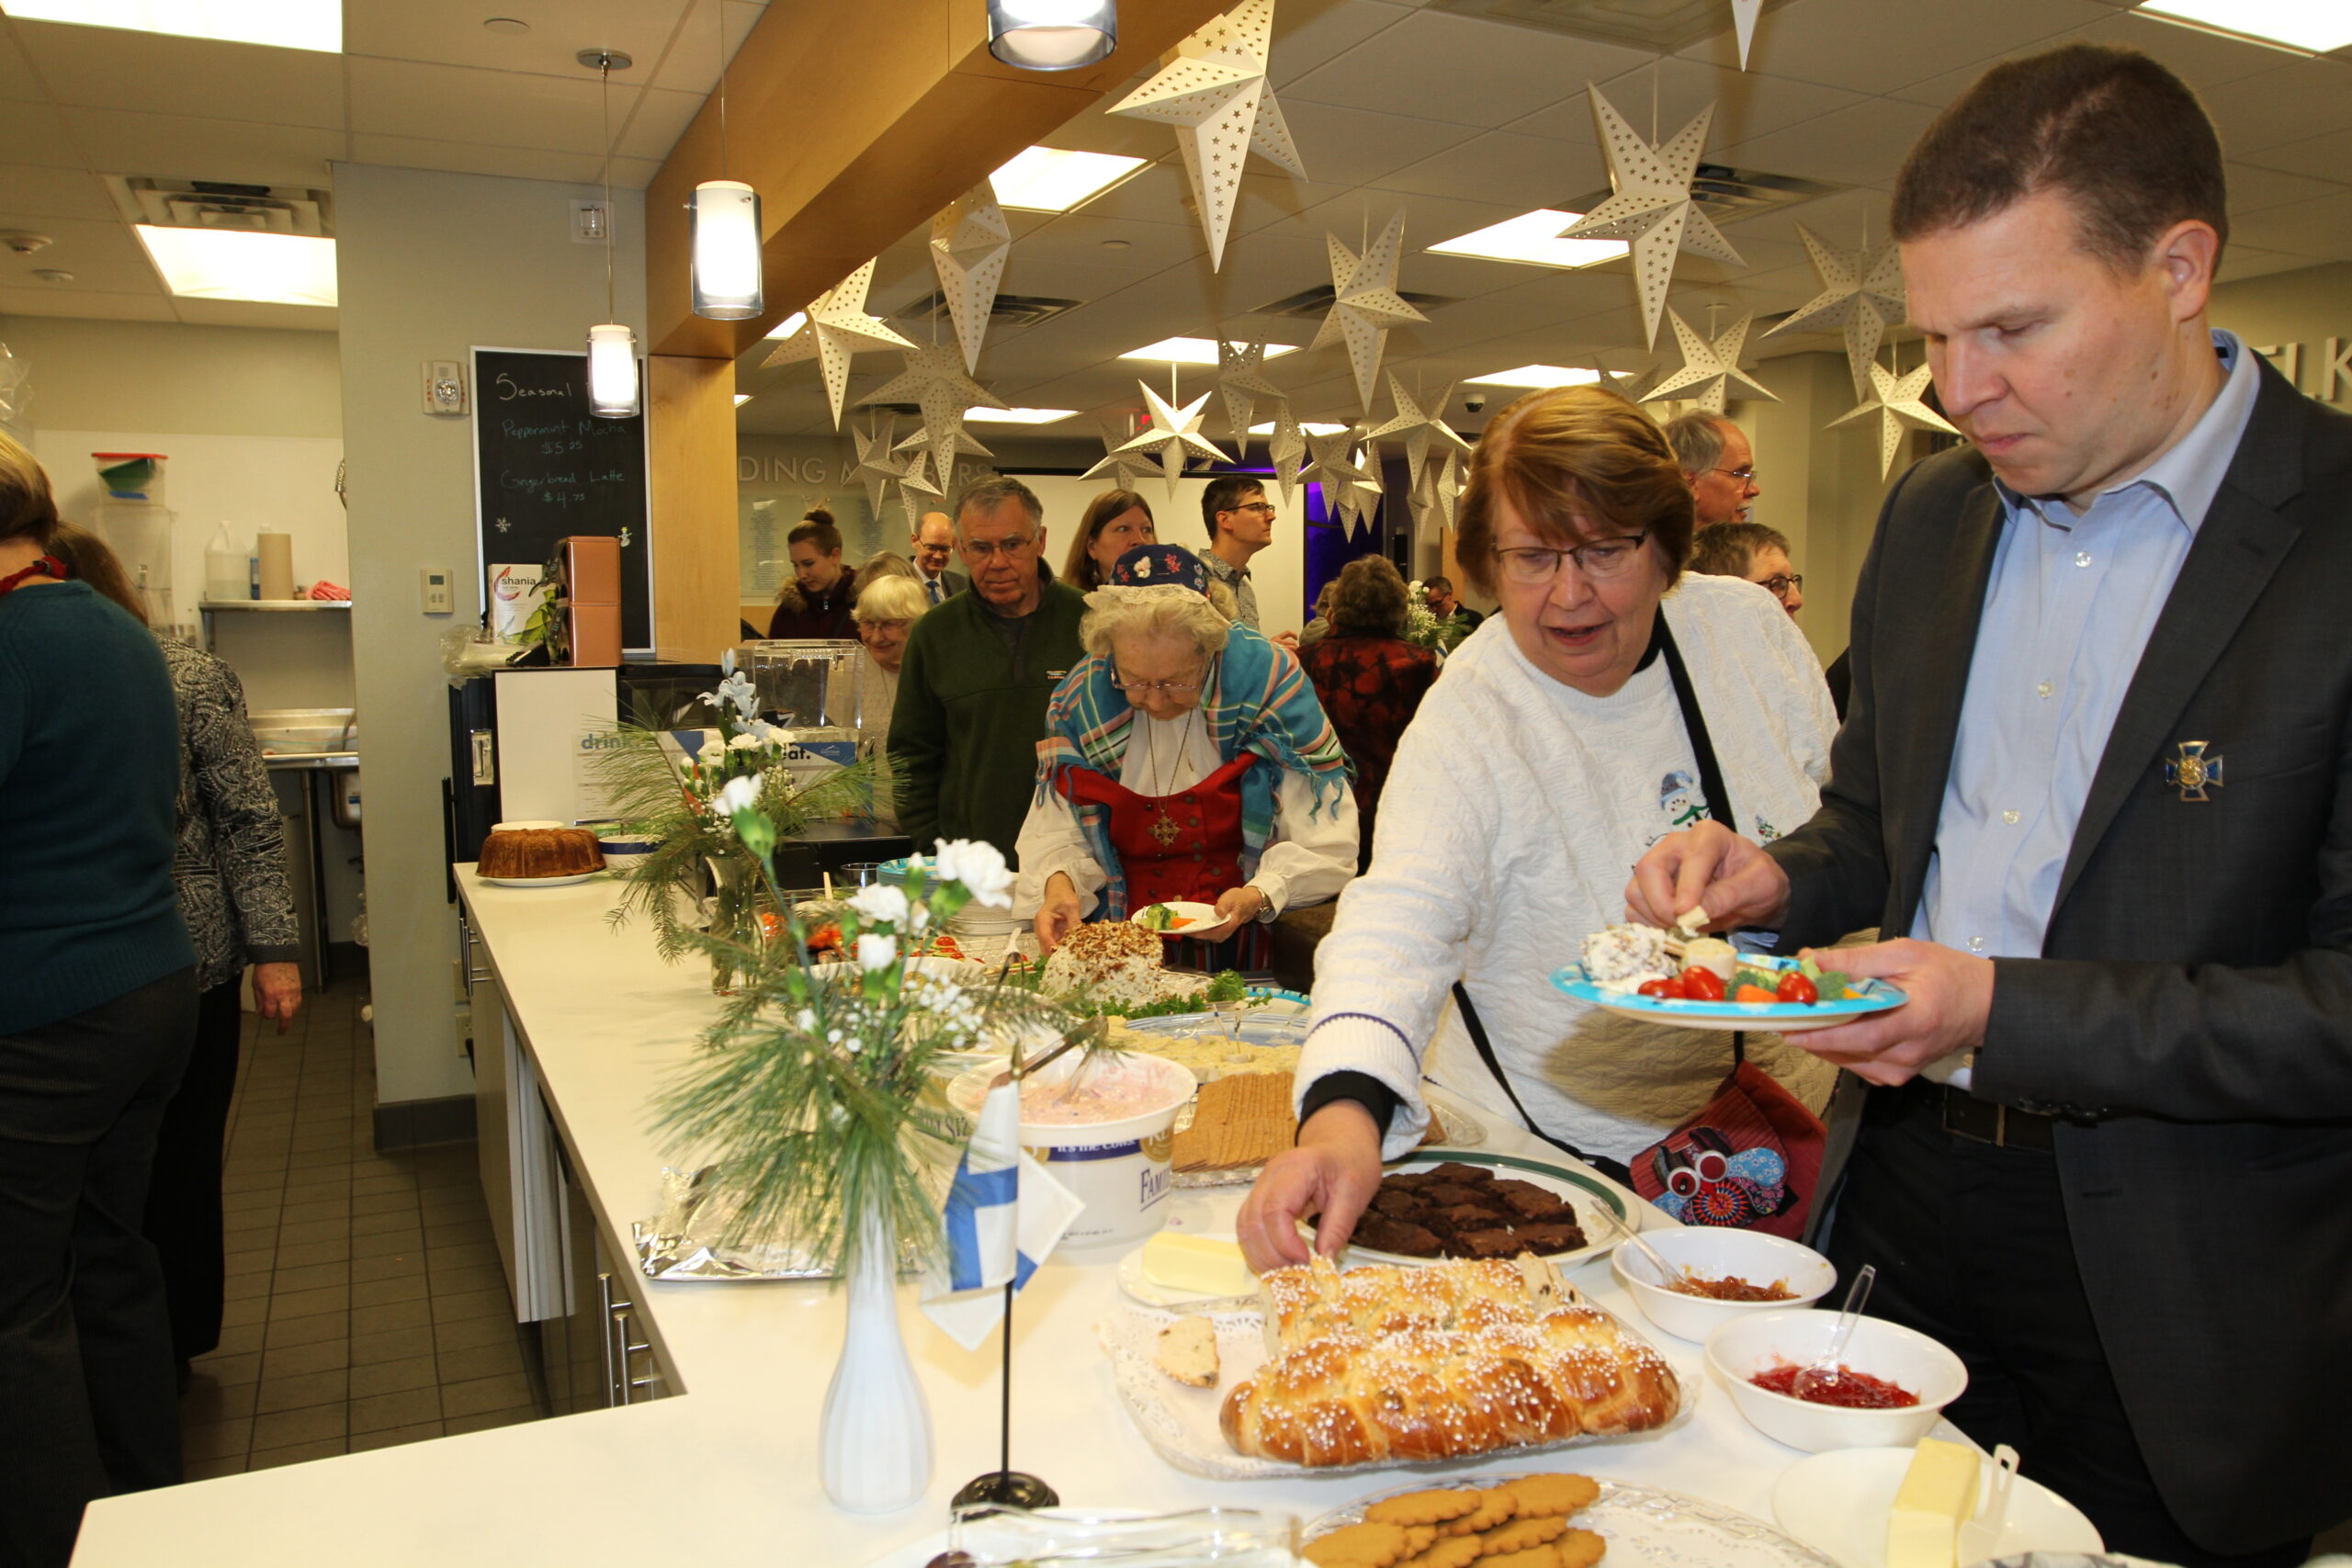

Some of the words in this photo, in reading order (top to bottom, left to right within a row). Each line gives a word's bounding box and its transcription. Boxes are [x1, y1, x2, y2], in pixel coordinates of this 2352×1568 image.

[2253, 337, 2352, 400] LK
[496, 373, 572, 400] Seasonal
[501, 418, 571, 439] Peppermint
[579, 420, 627, 436] Mocha
[500, 469, 576, 492] Gingerbread
[589, 469, 626, 482] Latte
[501, 576, 537, 585] shania
